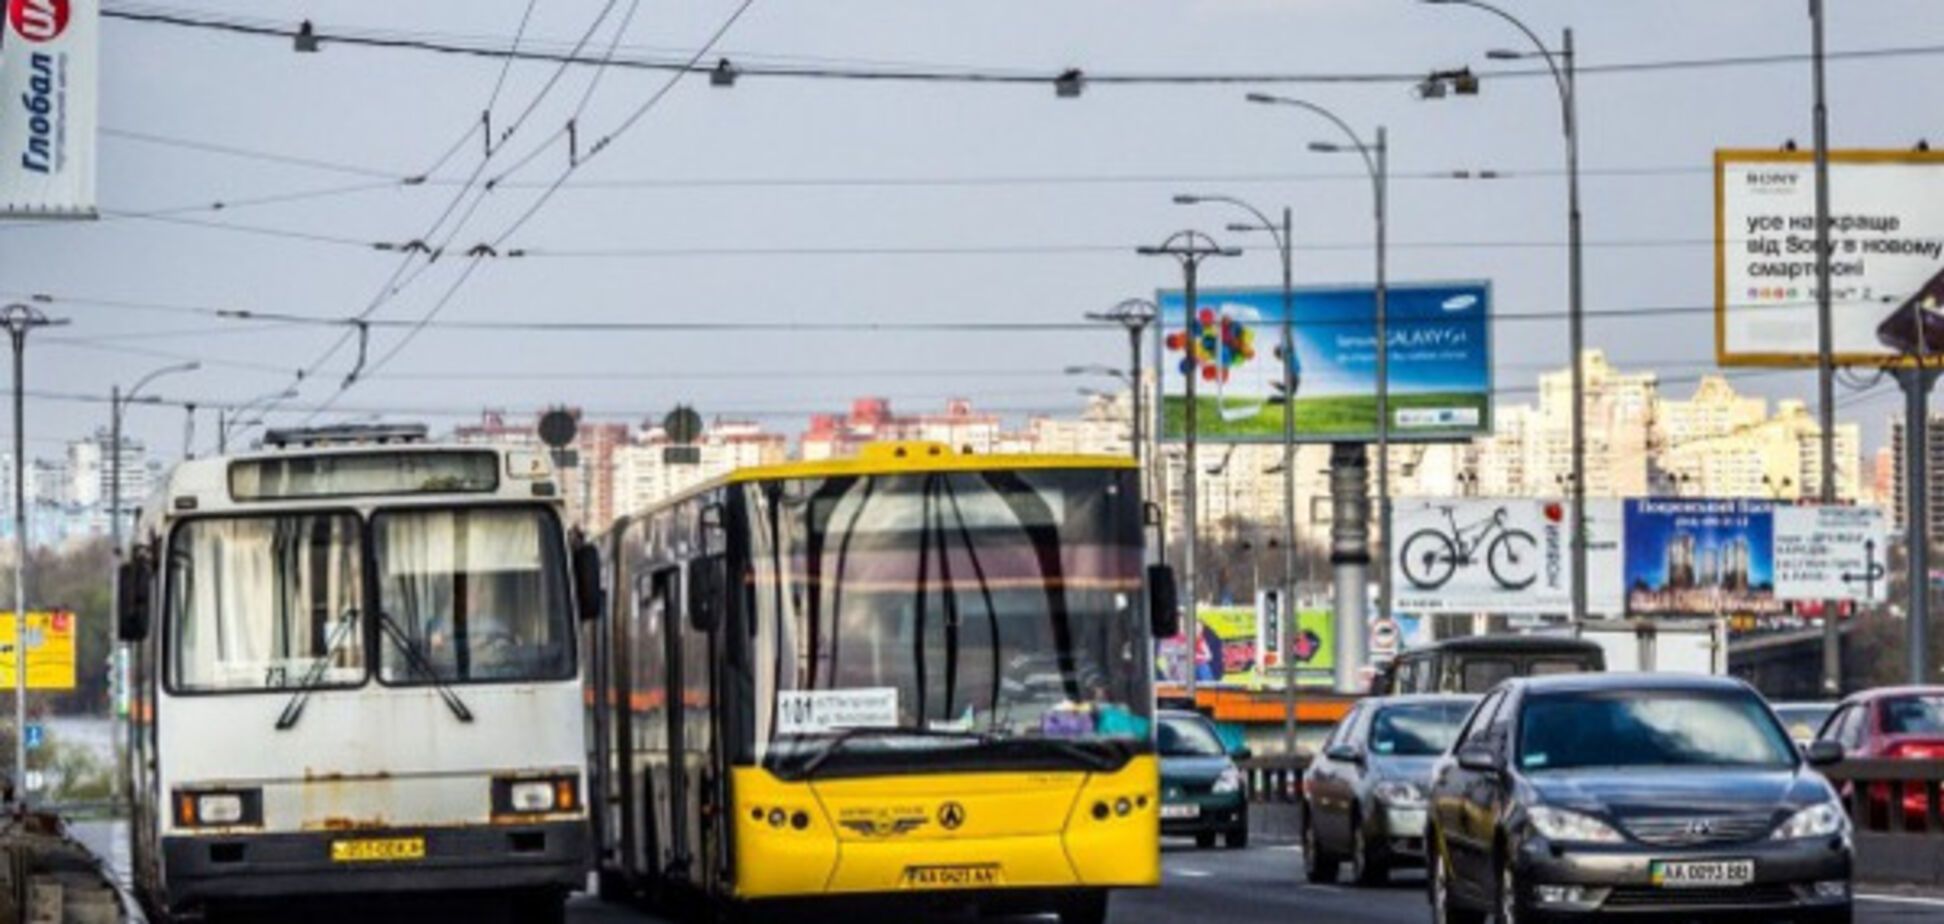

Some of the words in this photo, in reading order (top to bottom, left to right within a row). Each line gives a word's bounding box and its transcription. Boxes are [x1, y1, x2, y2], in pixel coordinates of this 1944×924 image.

[22, 52, 52, 174] Глобал
[1747, 216, 1783, 234] усе
[1789, 216, 1900, 234] накраще
[1747, 236, 1780, 257] від
[1786, 235, 1838, 256] Soy
[1843, 240, 1857, 253] в
[1862, 239, 1942, 260] новому
[1747, 259, 1864, 280] смартоні
